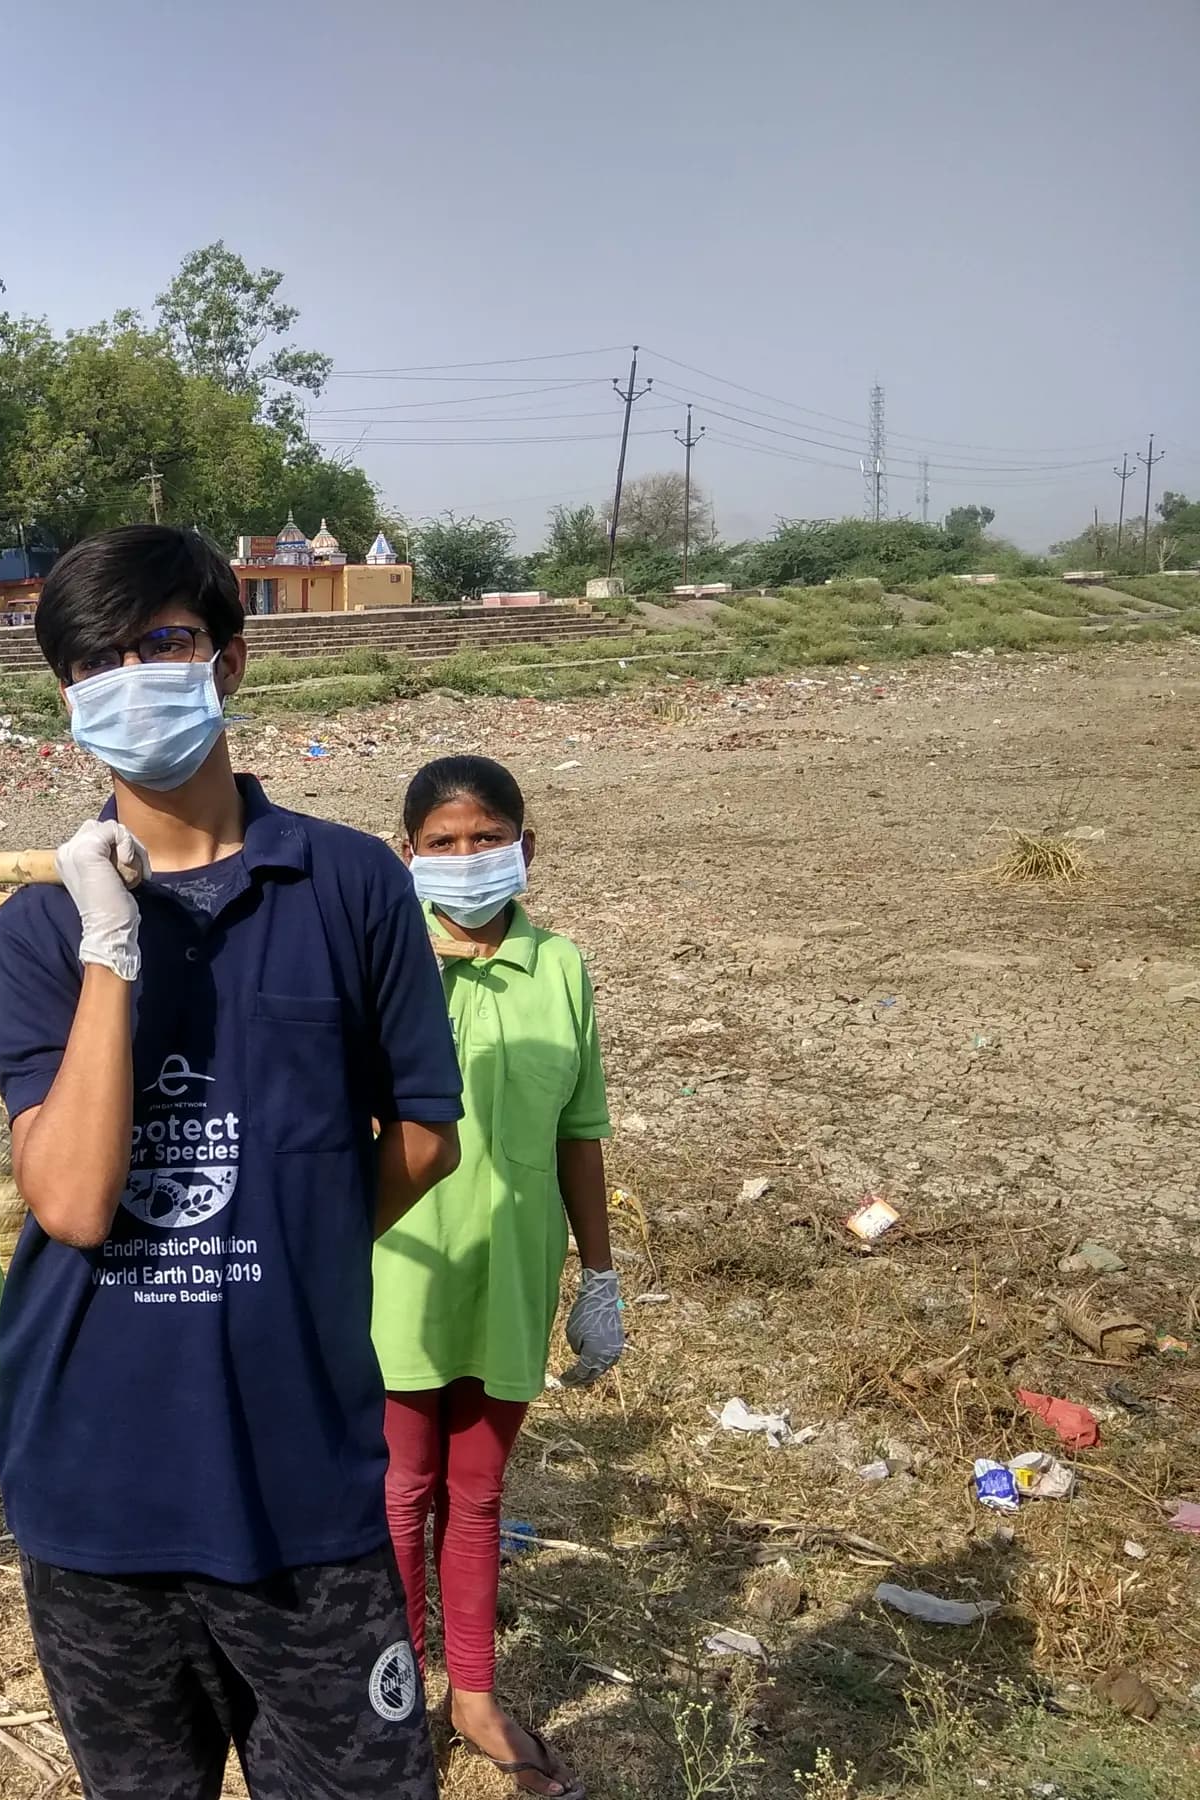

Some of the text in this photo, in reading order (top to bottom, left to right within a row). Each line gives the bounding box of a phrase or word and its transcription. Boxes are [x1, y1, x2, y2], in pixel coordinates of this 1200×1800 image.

[132, 1112, 240, 1145] otect
[154, 1140, 240, 1165] Species
[91, 1263, 262, 1288] World Earth Day 2019
[133, 1289, 223, 1303] Nature Bodies
